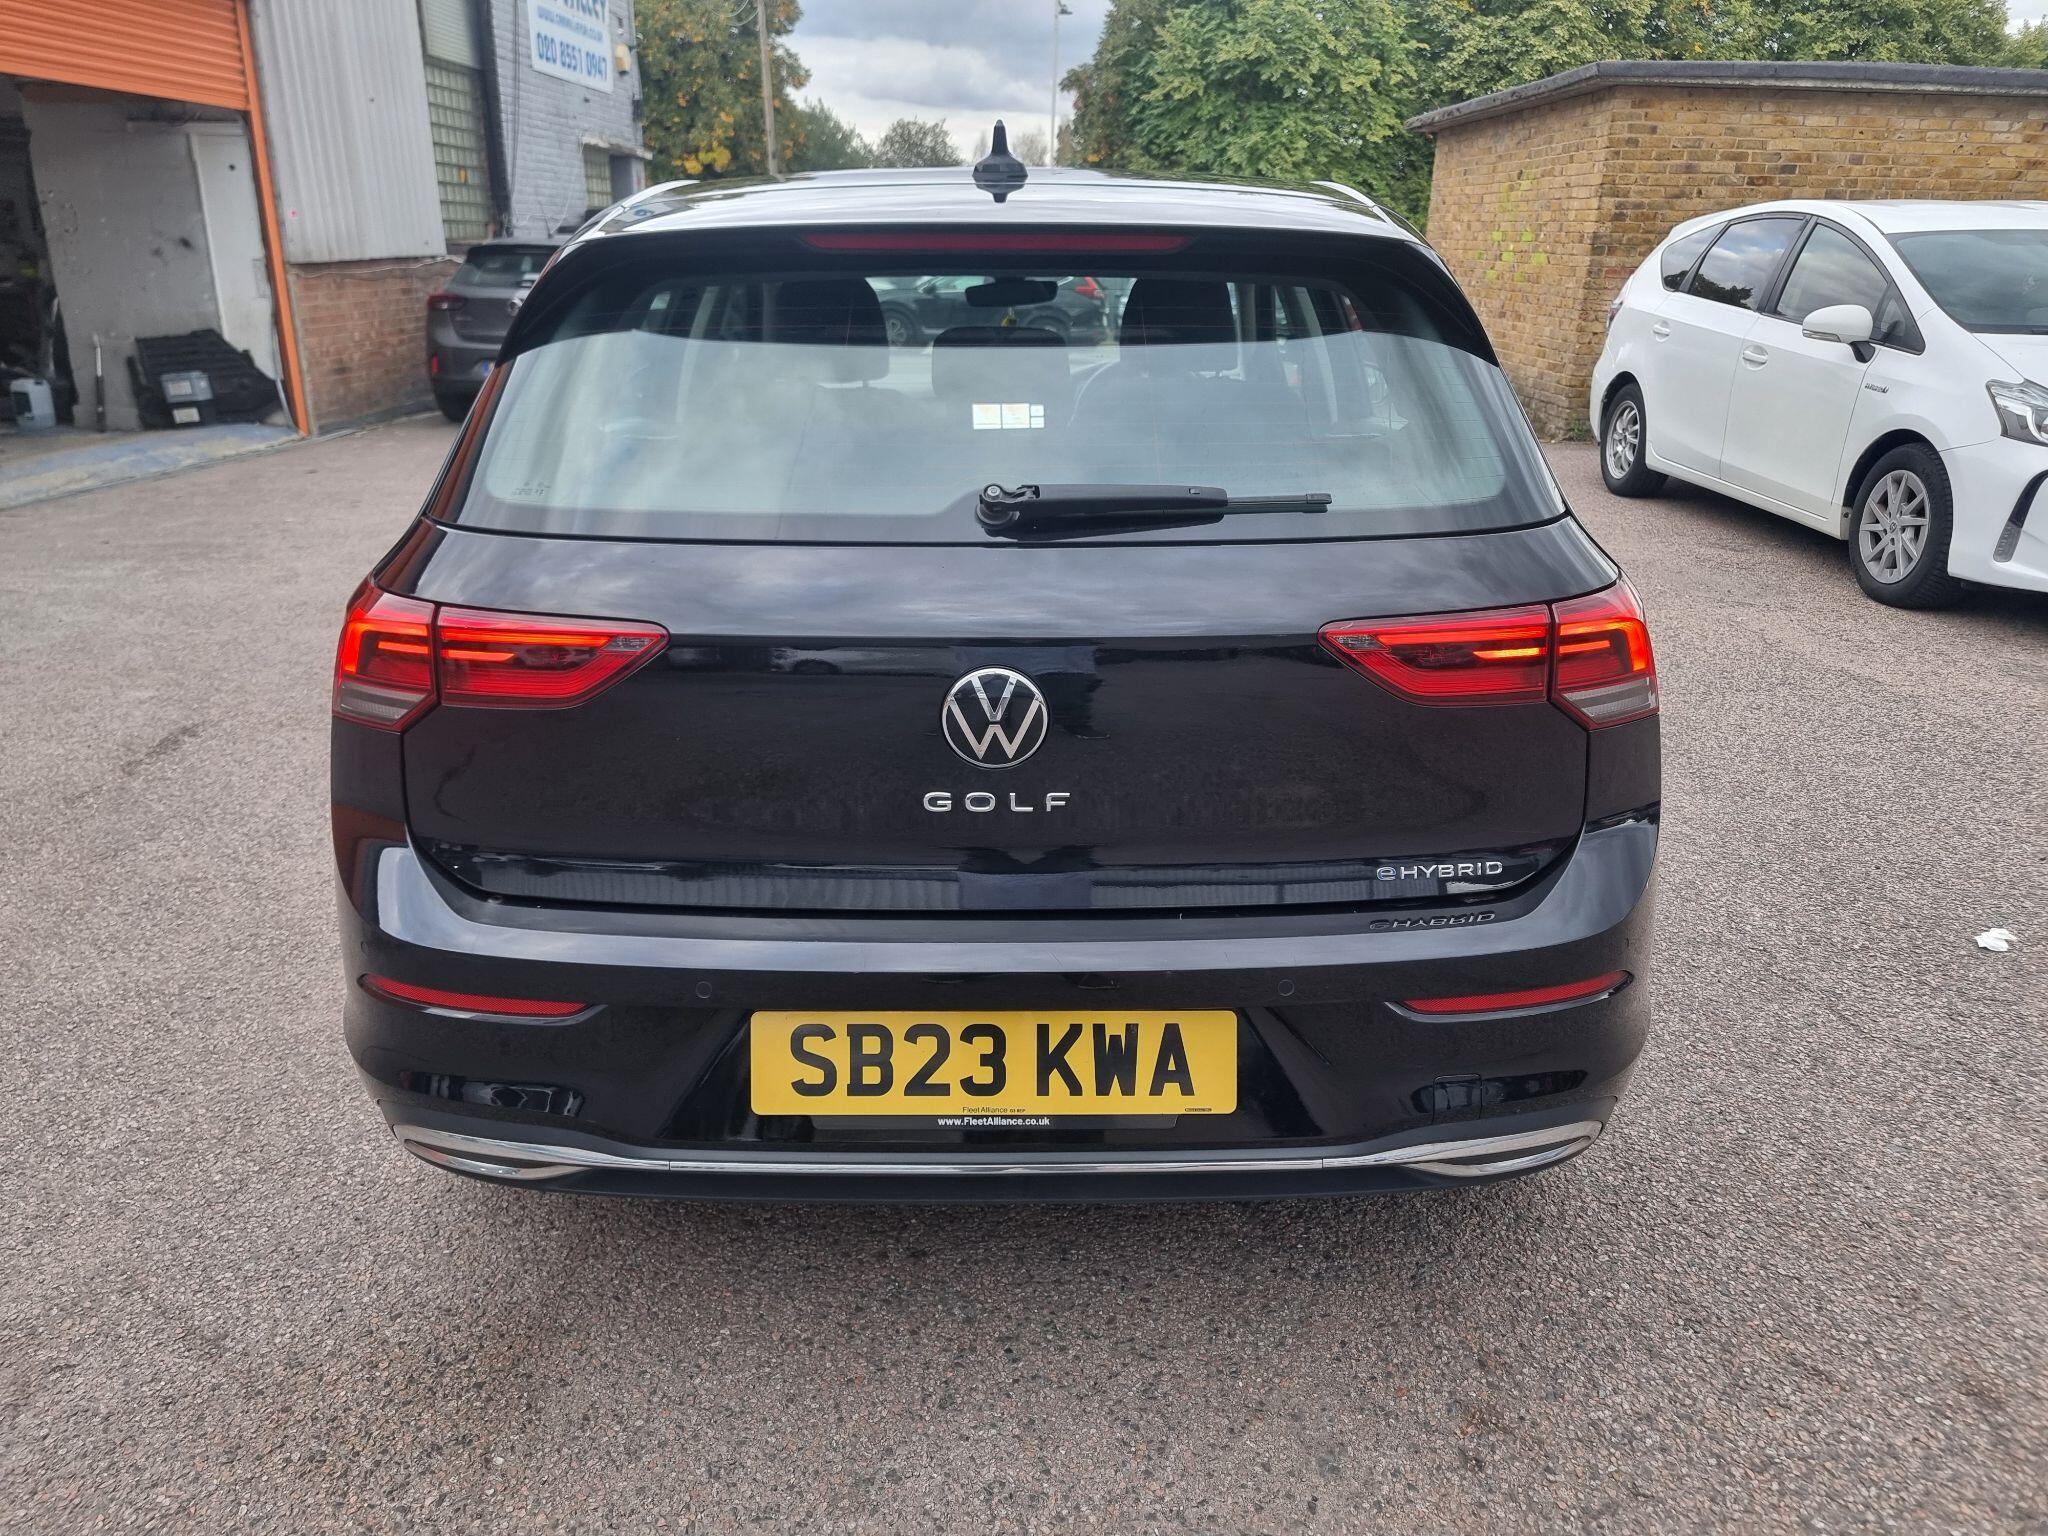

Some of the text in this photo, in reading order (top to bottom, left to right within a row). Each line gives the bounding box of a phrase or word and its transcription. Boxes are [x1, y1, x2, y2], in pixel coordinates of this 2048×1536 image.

[536, 32, 608, 81] 020 8551 0947
[923, 791, 1071, 812] GOLF
[1376, 861, 1503, 882] eHYBRID
[790, 1023, 1195, 1097] SB23 KWA
[937, 1116, 1050, 1126] www.FleetAlliance.co.uk
